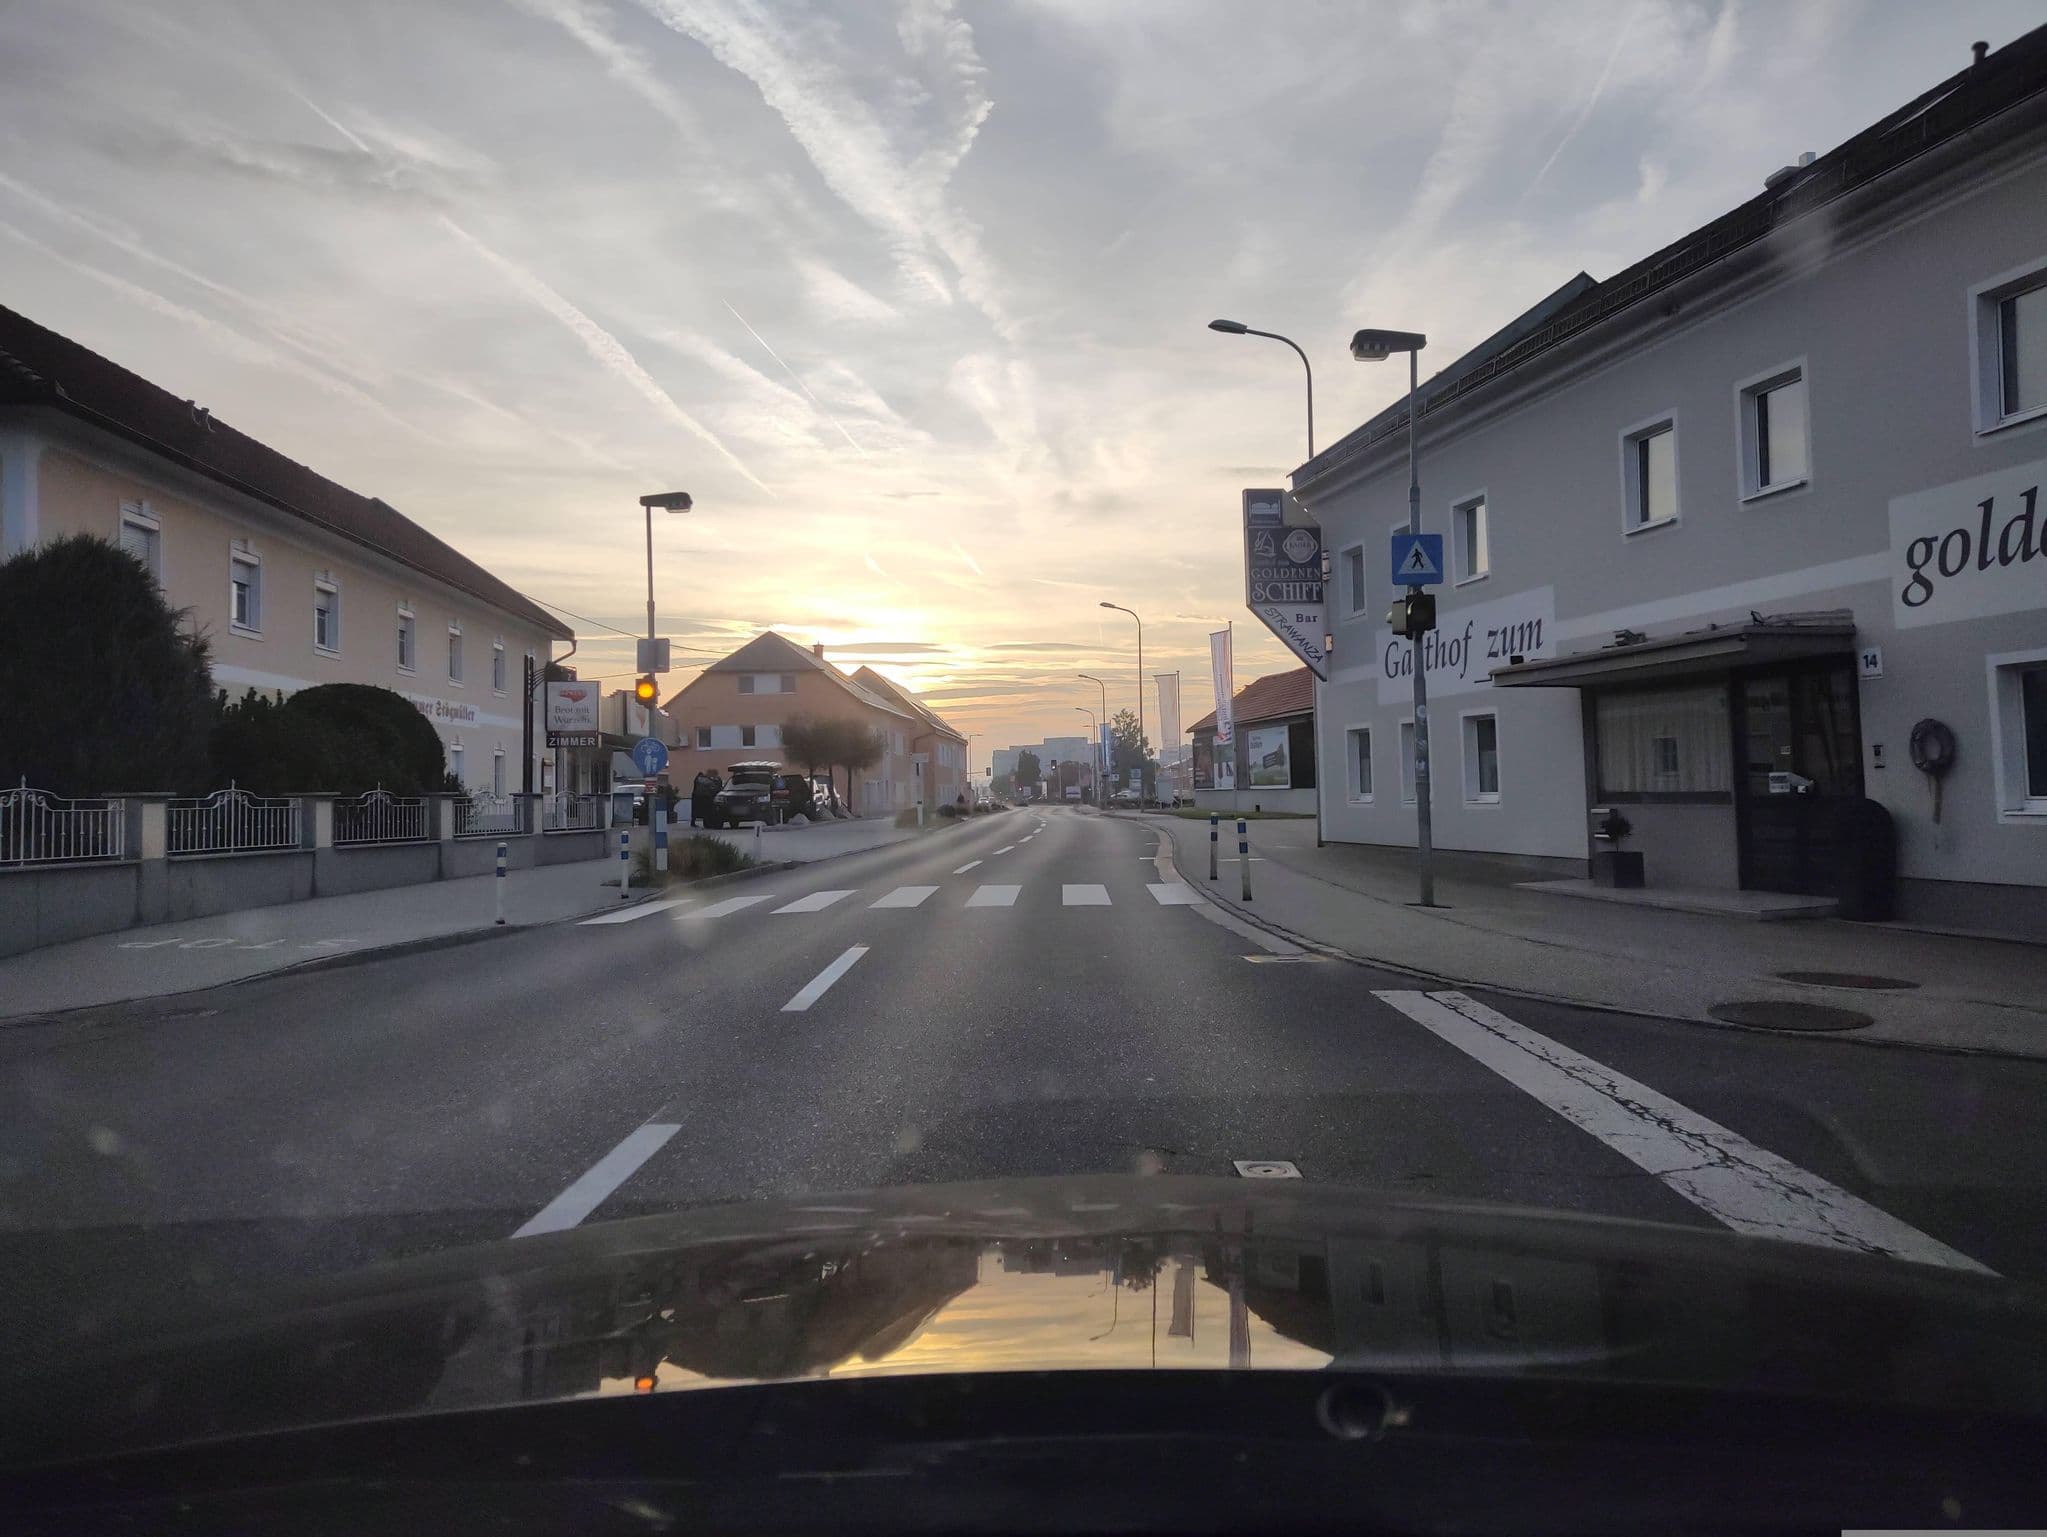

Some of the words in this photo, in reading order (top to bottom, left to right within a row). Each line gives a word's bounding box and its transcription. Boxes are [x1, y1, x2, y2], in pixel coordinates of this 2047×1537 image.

[1901, 485, 2047, 608] gold
[1251, 567, 1321, 580] GOLDENEN
[1252, 582, 1322, 602] SCHIFF
[1295, 613, 1318, 623] Bar
[1264, 607, 1324, 664] STRAWANZA
[1384, 619, 1474, 680] Gathof
[1486, 617, 1544, 658] zum
[1863, 654, 1878, 669] 14
[548, 737, 596, 746] ZIMMER
